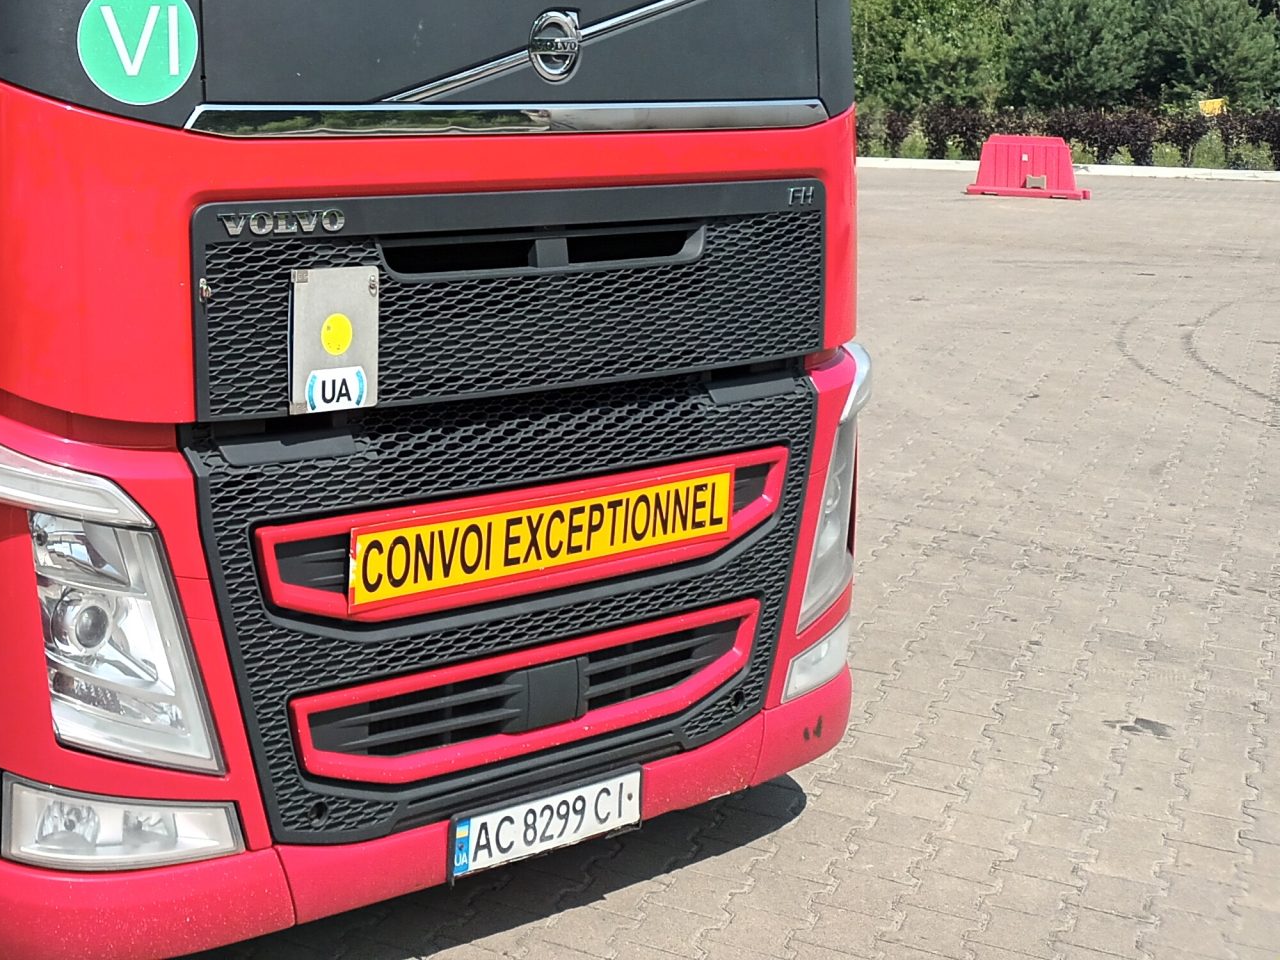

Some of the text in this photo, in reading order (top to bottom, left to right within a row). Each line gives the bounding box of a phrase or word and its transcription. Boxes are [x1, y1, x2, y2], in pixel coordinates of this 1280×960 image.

[99, 5, 180, 77] VI
[788, 186, 815, 205] FH
[217, 208, 345, 236] VOLVO
[321, 378, 352, 404] UA
[361, 482, 723, 593] CONVOI EXCEPTIONNEL
[523, 795, 586, 847] 8299
[454, 853, 468, 867] UA
